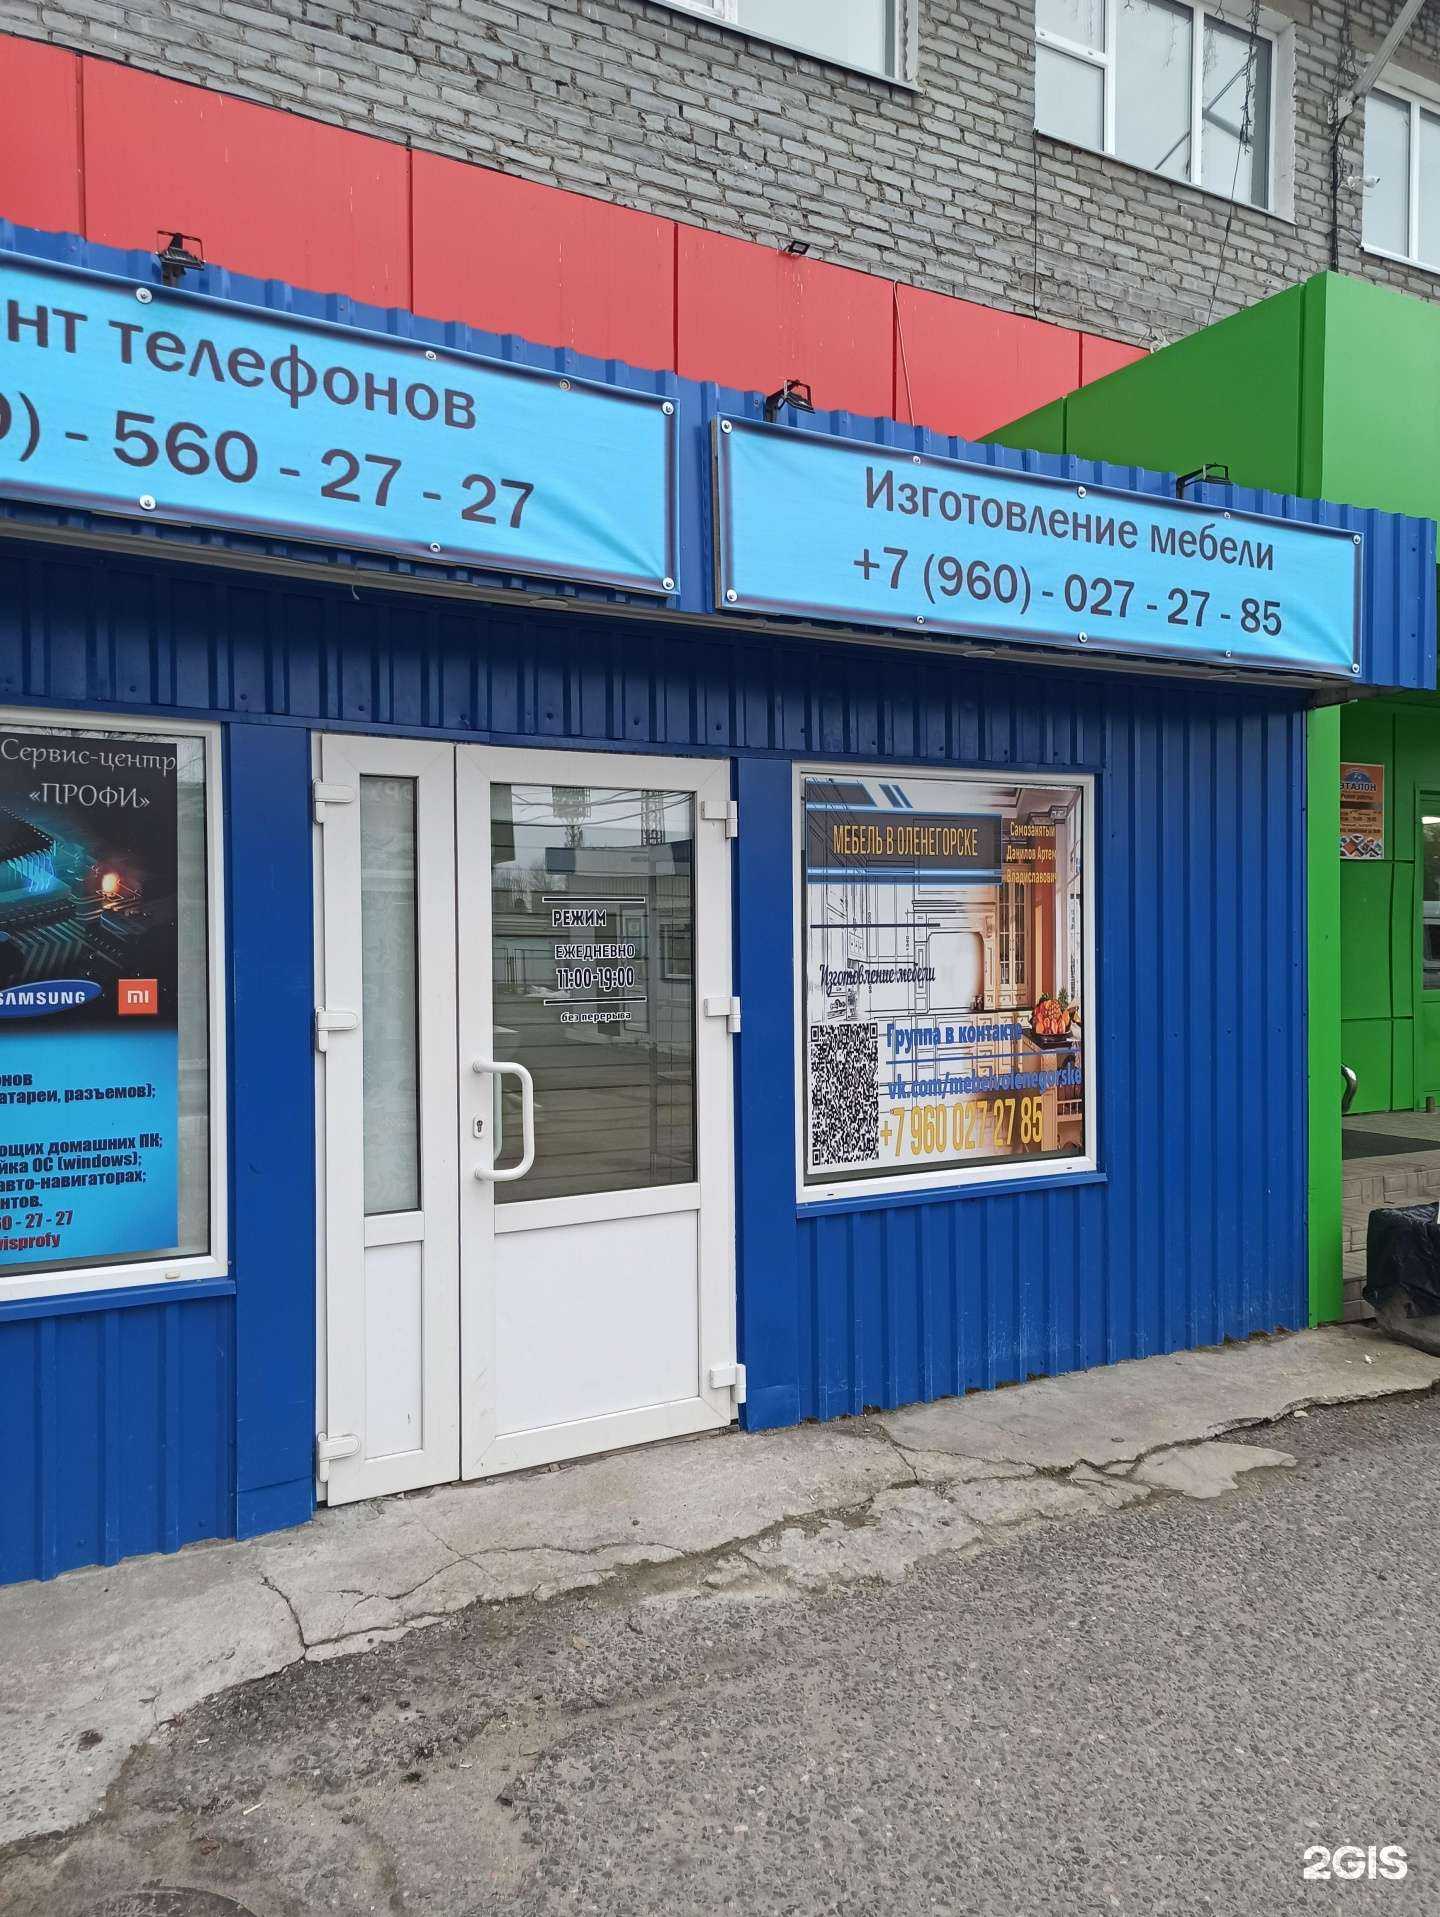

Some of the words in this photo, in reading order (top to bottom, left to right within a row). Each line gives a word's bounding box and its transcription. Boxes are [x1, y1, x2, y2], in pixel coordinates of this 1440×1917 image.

[109, 319, 478, 430] телефонов
[113, 410, 258, 484] 560
[320, 448, 402, 507] 27
[461, 474, 535, 529] 27
[865, 466, 1138, 549] Изготовление
[1150, 523, 1275, 571] мебели
[853, 547, 908, 590] +7
[923, 553, 1031, 614] (960)
[1064, 574, 1135, 618] 027
[1167, 587, 1210, 627] 27
[1240, 598, 1282, 637] 85
[1, 738, 177, 777] Сервис-центр
[29, 782, 150, 808] «ПРОФИ»
[833, 824, 883, 855] МЕБЕЛЬ
[886, 826, 894, 855] В
[897, 827, 978, 856] ОЛЕНЕГОРСКЕ
[552, 909, 607, 927] РЕЖИМ
[555, 943, 636, 961] ЕЖЕДНЕВНО
[556, 967, 634, 991] 11:00-19:00
[820, 964, 894, 997] Изготовление
[897, 966, 936, 983] мебели
[561, 1012, 580, 1022] без
[581, 1011, 631, 1023] перерыва
[886, 1024, 940, 1054] Группа
[946, 1027, 954, 1044] в
[959, 1023, 1023, 1042] контакте
[0, 1073, 33, 1087] нов
[880, 1106, 905, 1157] +7
[911, 1103, 947, 1155] 960
[952, 1101, 988, 1151] 027
[993, 1098, 1016, 1147] 27
[1020, 1096, 1044, 1144] 85
[48, 1137, 136, 1156] домашних
[0, 1215, 12, 1231] 0
[25, 1212, 43, 1229] 27
[55, 1210, 74, 1226] 27
